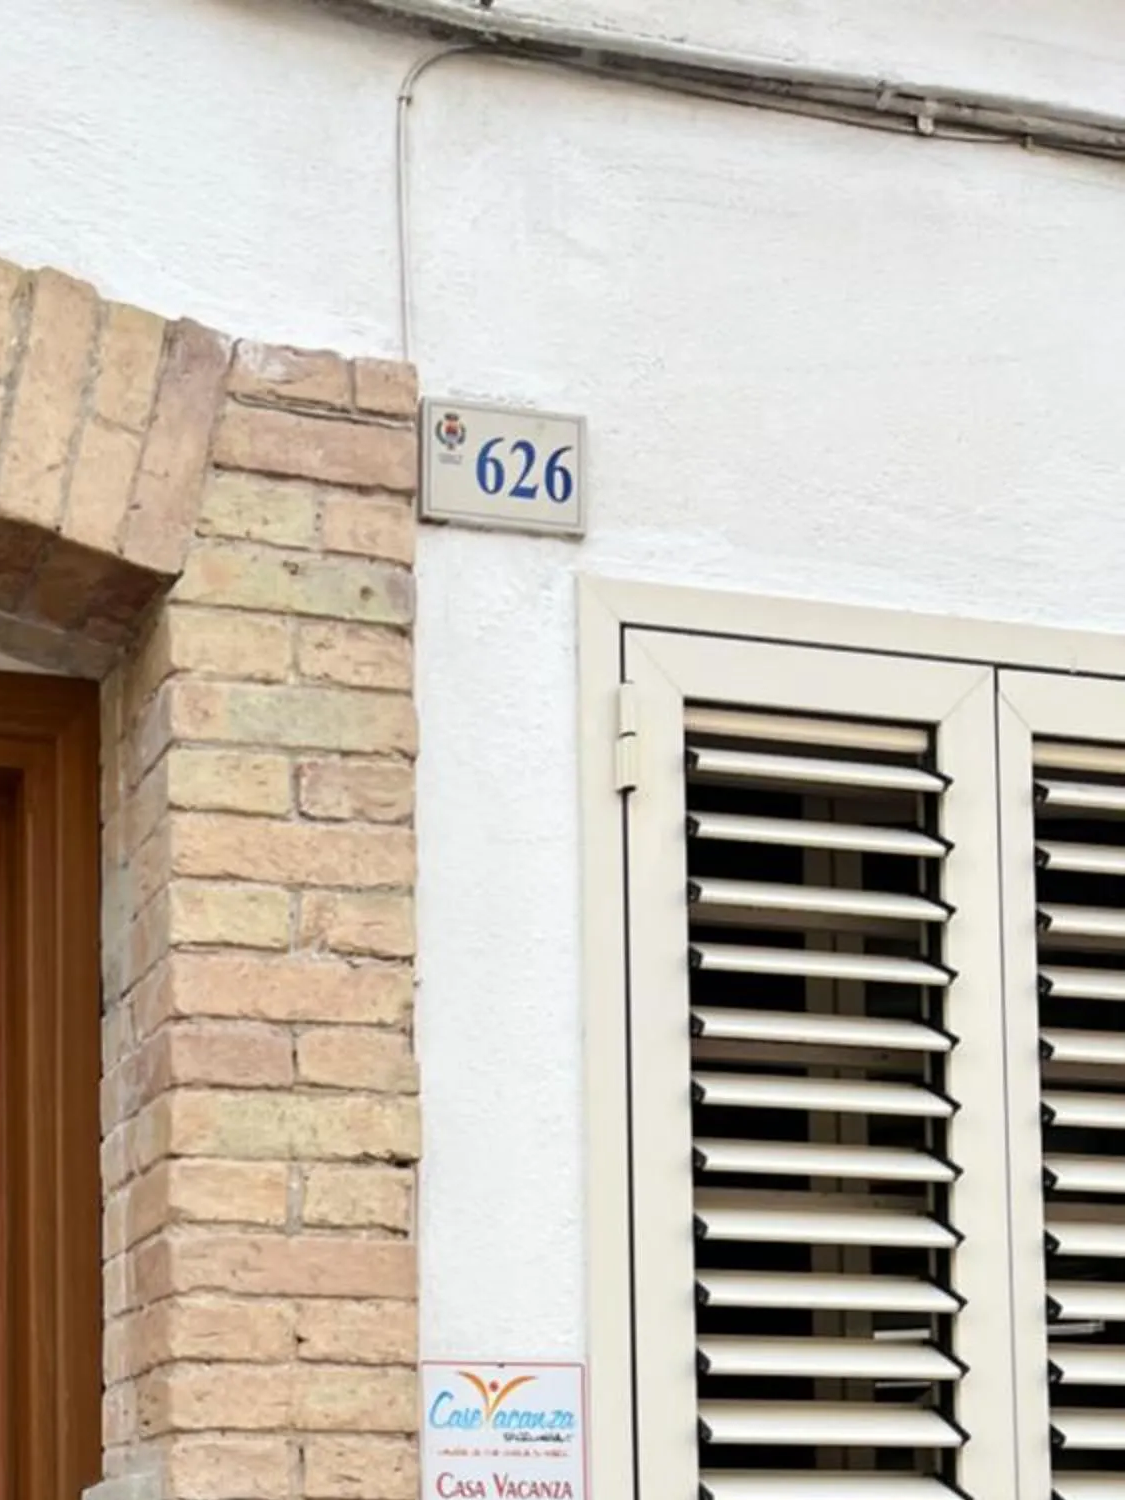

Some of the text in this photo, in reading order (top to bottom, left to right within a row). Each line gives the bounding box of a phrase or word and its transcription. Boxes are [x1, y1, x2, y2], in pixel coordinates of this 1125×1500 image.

[476, 436, 573, 503] 626
[436, 1471, 573, 1500] CASA VACANZA
